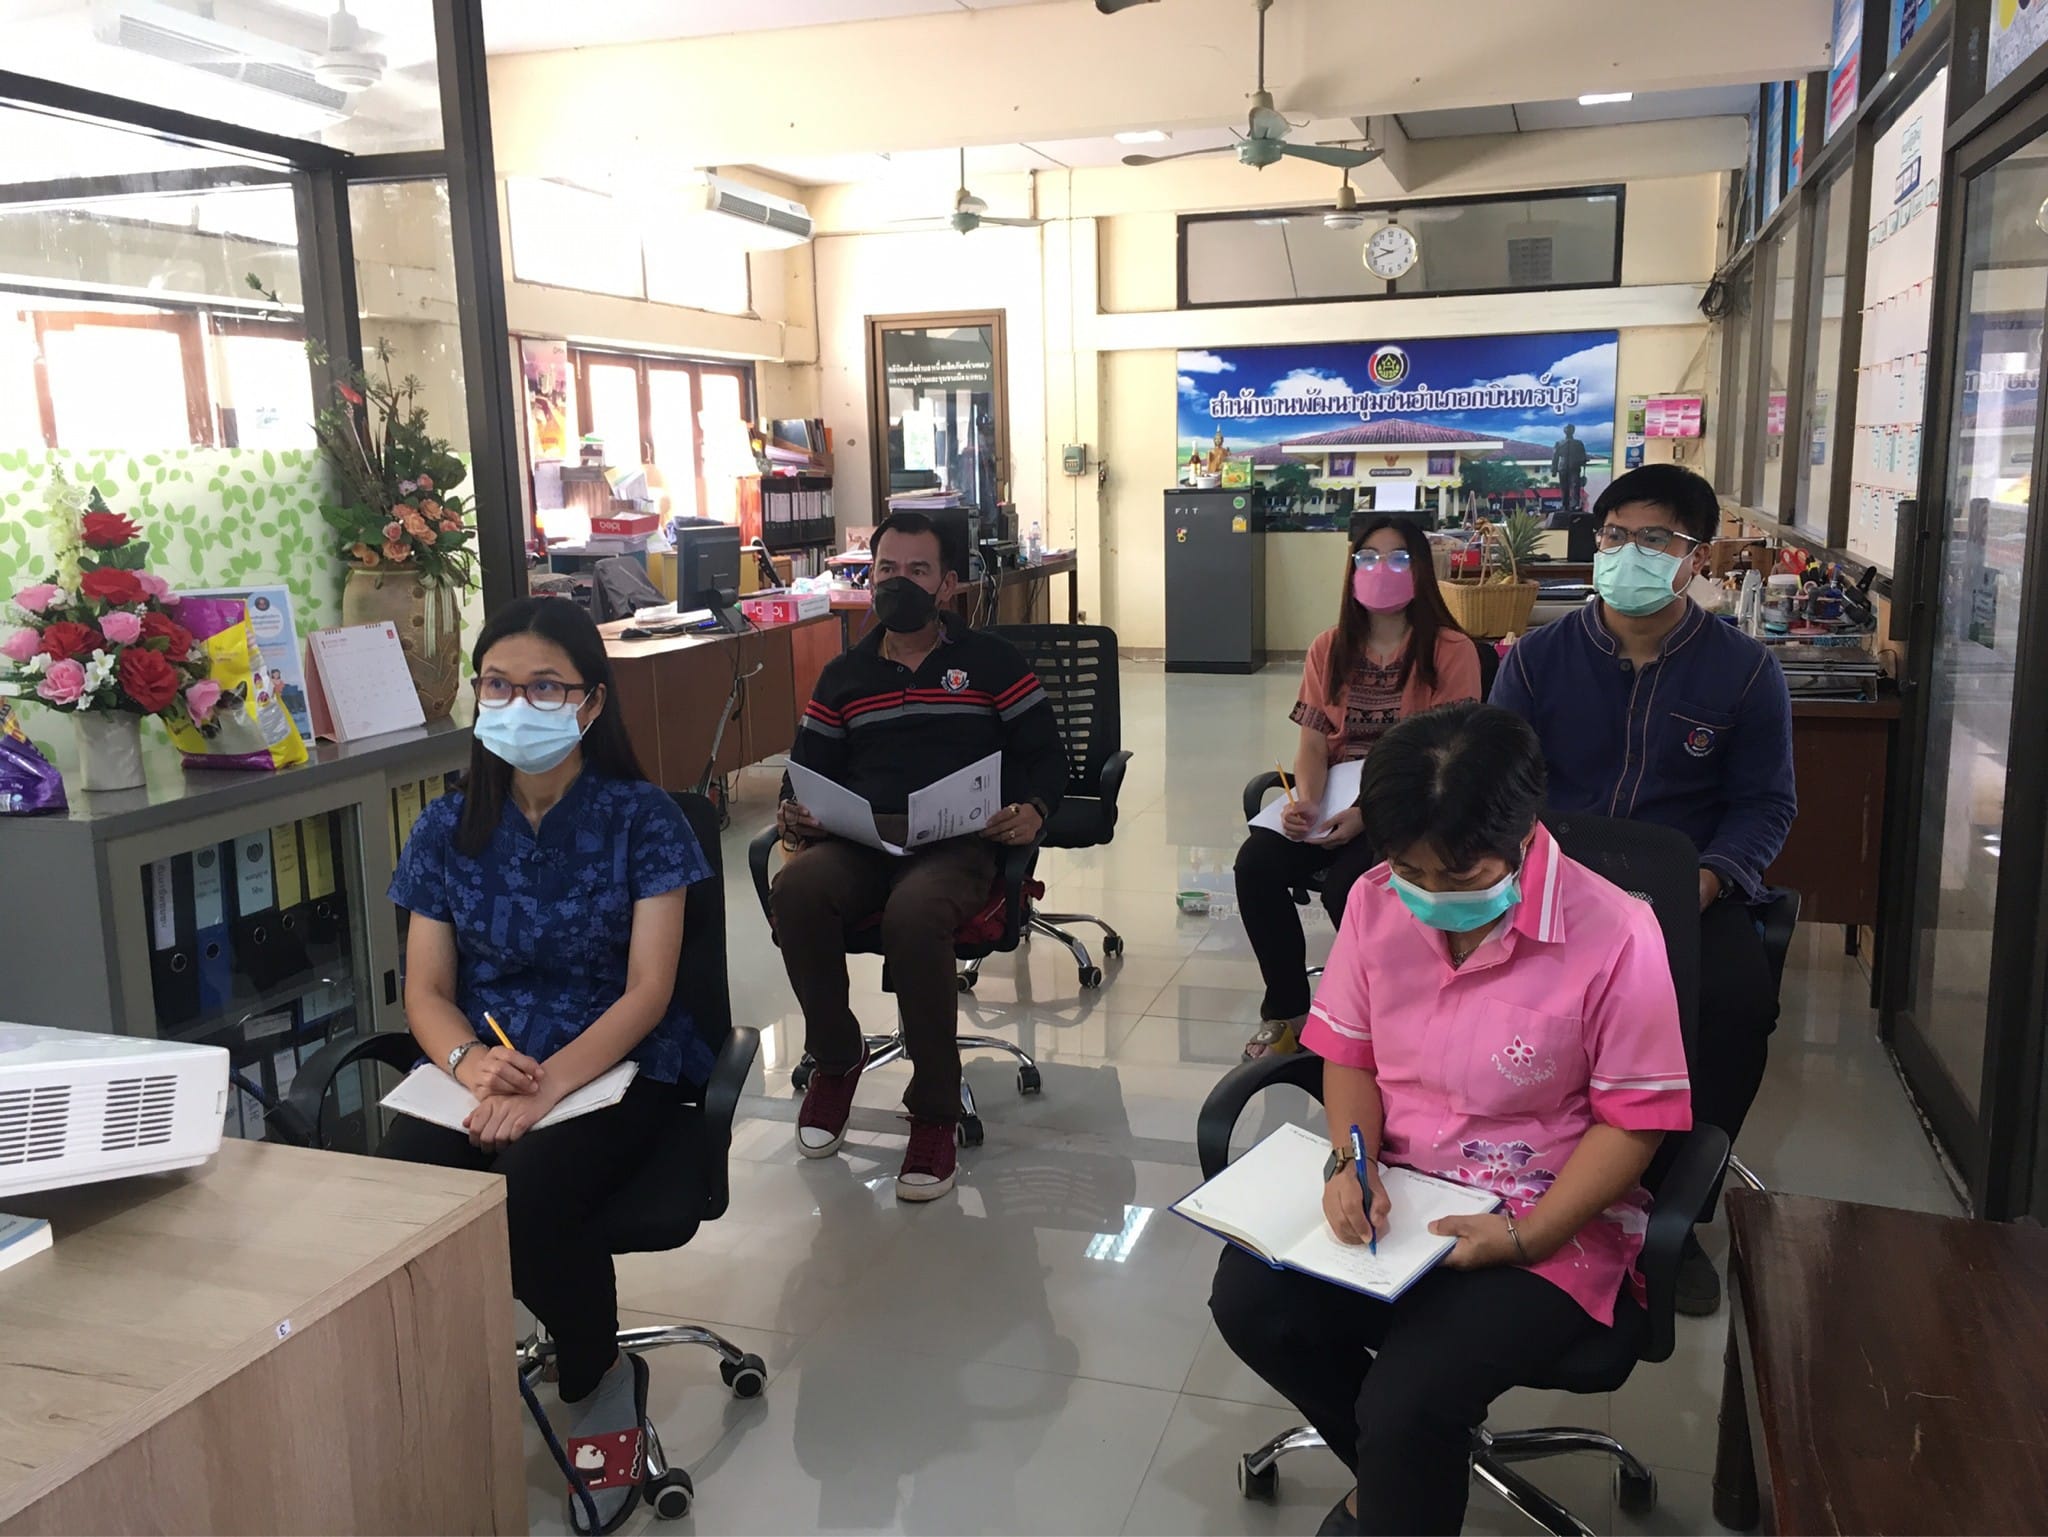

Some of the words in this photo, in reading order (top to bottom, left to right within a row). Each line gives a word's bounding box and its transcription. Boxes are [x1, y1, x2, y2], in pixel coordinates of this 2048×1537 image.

[1210, 373, 1579, 420] สำนักงานพัฒนาชุมชนอำเภอกบินทร์บุรี
[1175, 507, 1199, 515] FIT
